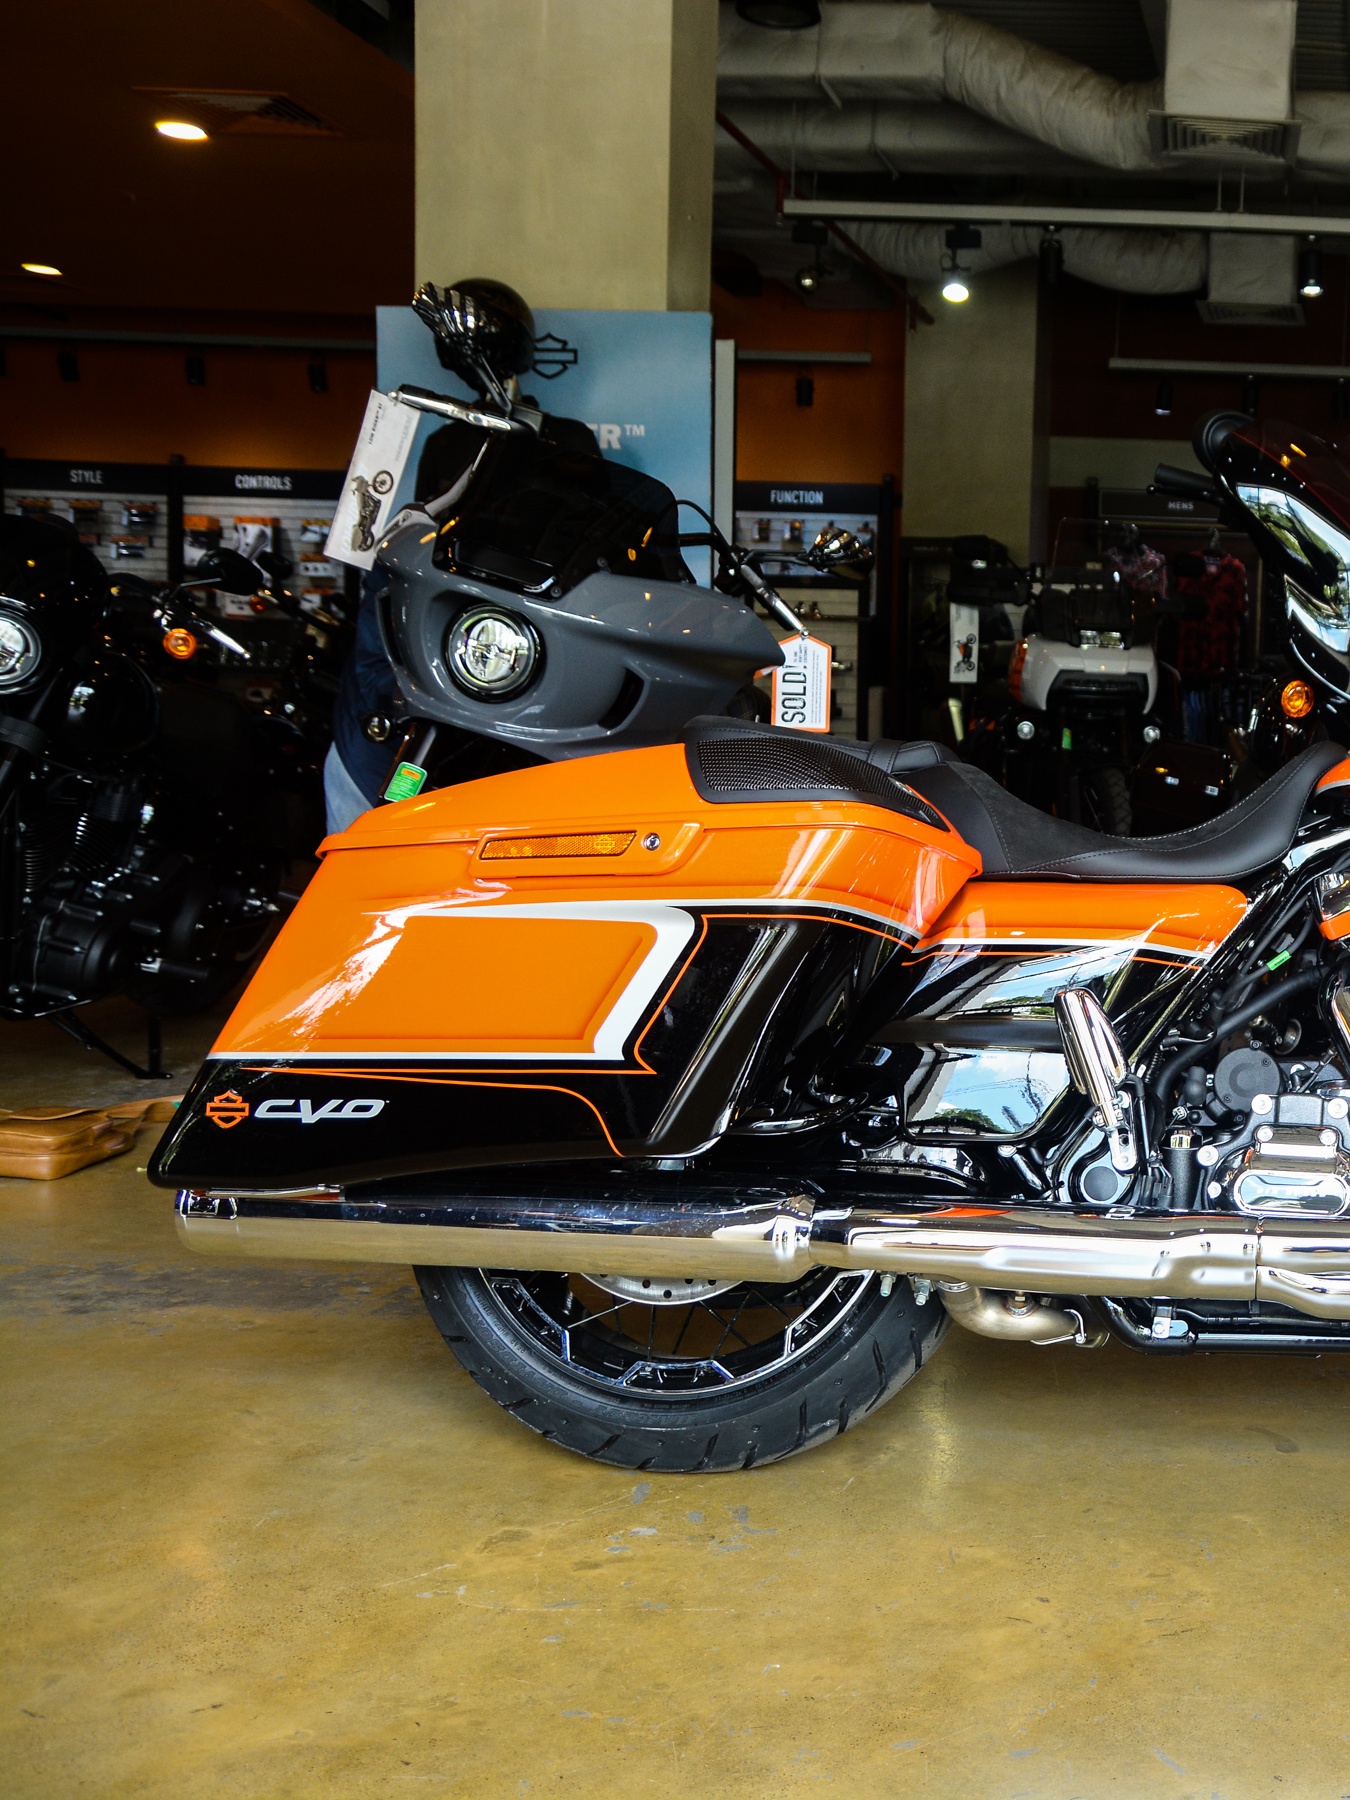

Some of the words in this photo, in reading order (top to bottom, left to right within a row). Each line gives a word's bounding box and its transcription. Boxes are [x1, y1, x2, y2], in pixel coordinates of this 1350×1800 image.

[69, 469, 104, 484] STYLE
[234, 474, 292, 491] CONTROLS
[770, 489, 824, 505] FUNCTION
[1167, 501, 1194, 510] MENS
[781, 665, 807, 724] SOLD!
[254, 1099, 386, 1124] CVO
